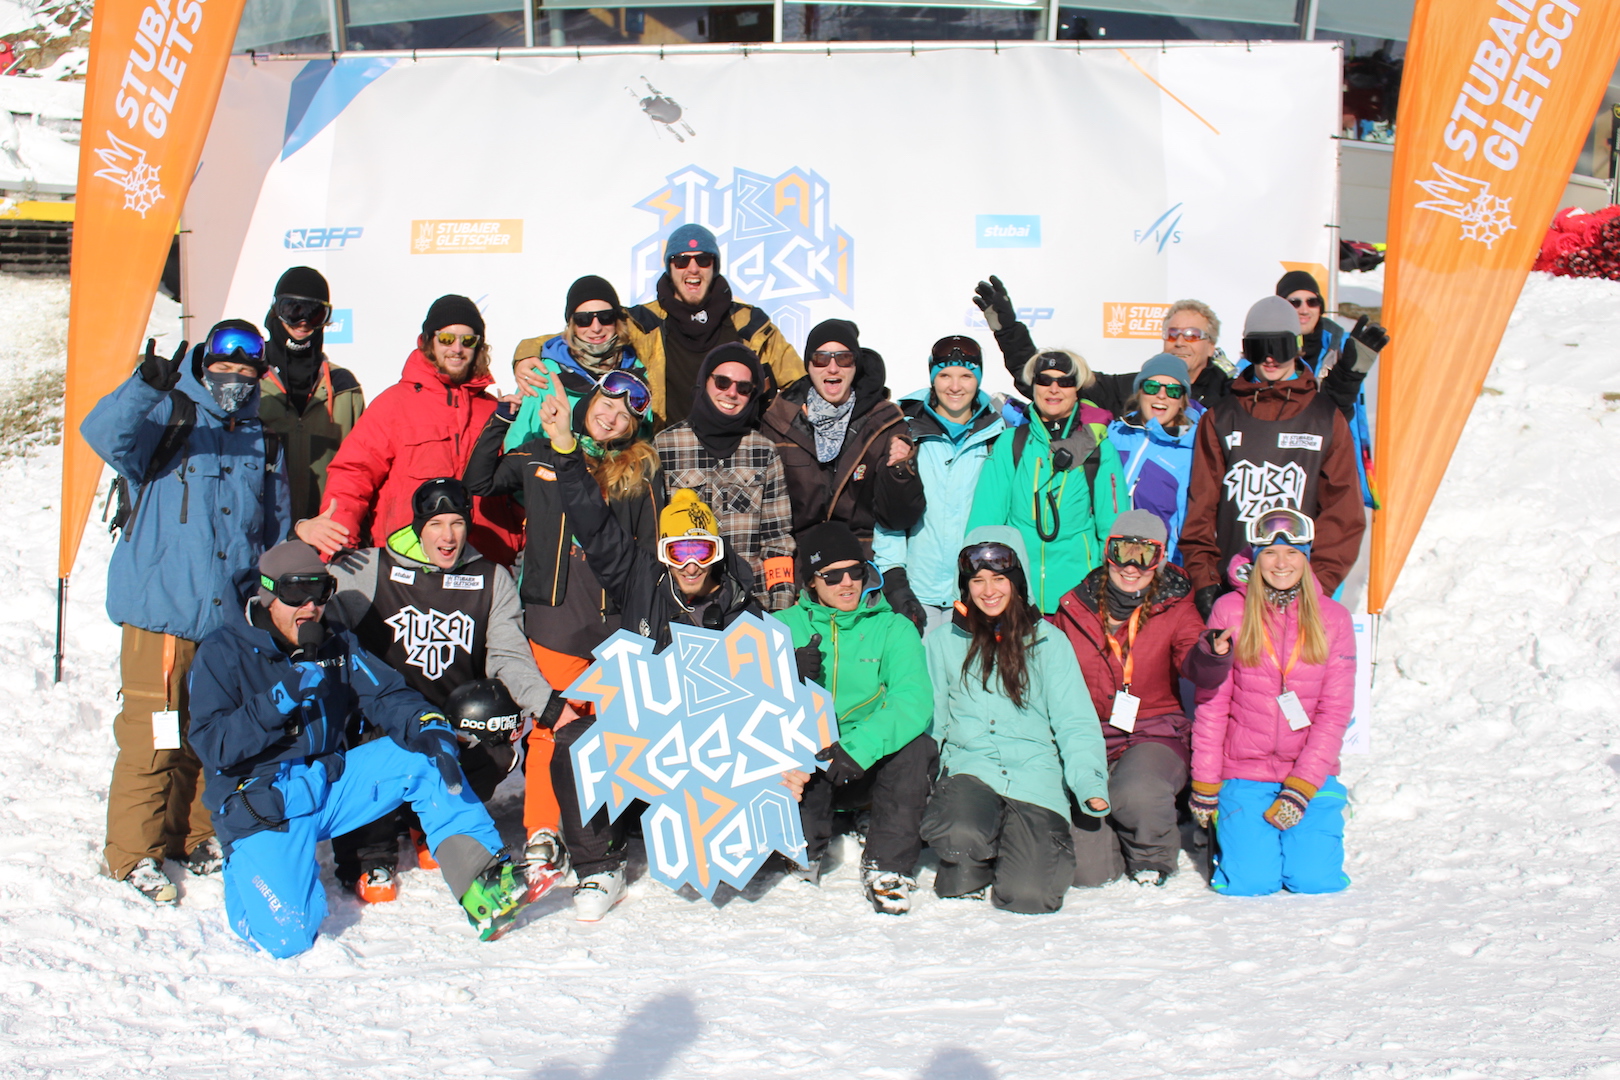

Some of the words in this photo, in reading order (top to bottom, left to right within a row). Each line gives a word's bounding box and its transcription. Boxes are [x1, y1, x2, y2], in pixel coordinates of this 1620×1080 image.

[143, 0, 208, 139] GLETS
[436, 222, 500, 234] STUBAIER
[984, 224, 1030, 237] stubai
[436, 234, 510, 246] GLETSCHER
[765, 566, 791, 580] REW
